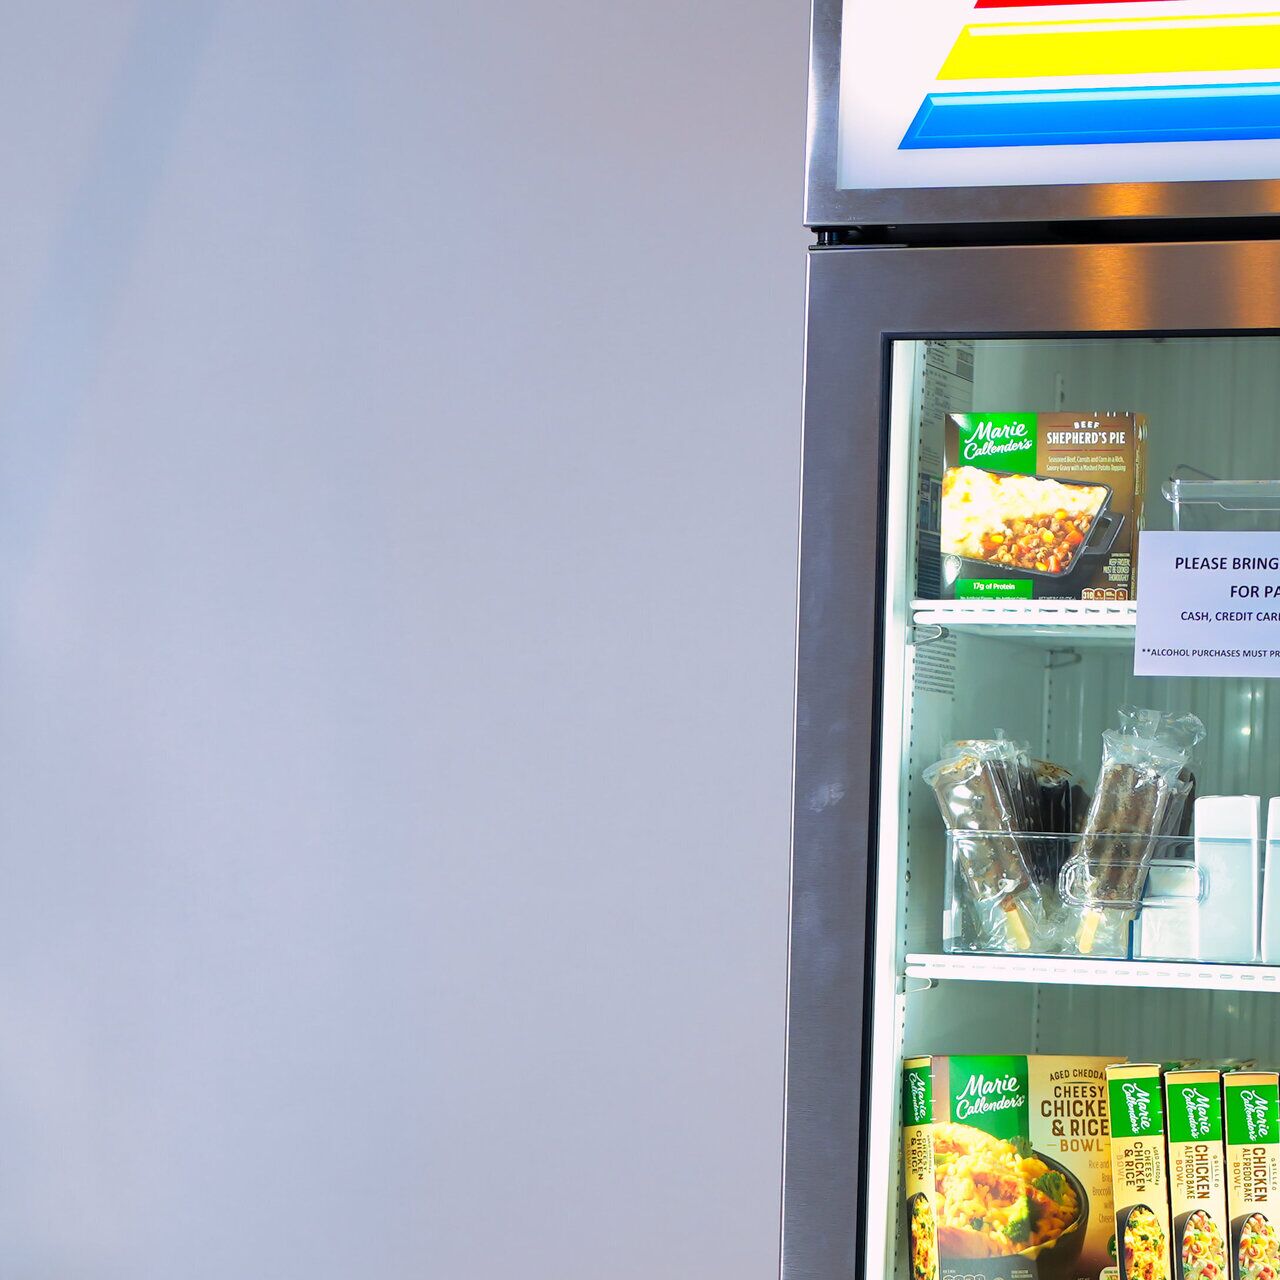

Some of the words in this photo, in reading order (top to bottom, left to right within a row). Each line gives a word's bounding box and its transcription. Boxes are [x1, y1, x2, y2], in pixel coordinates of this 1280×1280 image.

[1074, 421, 1100, 429] BEEF
[964, 421, 1028, 444] Marie
[1046, 432, 1108, 444] SHEPHERD'S
[1109, 432, 1125, 444] PIE
[964, 439, 1032, 460] Callender's
[1175, 557, 1228, 571] PLEASE
[1232, 557, 1279, 571] BRING
[973, 582, 984, 591] 17g
[993, 582, 1016, 590] Protein
[1230, 585, 1259, 599] FOR
[1181, 611, 1212, 622] CASH,
[1215, 611, 1253, 622] CREDIT
[1192, 650, 1241, 658] PURCHASES
[1242, 650, 1267, 658] MUST
[1050, 1070, 1070, 1081] AGED
[956, 1074, 1020, 1101] Marie
[1054, 1086, 1105, 1098] CHEESY
[955, 1095, 1025, 1120] Callender's
[1182, 1088, 1198, 1139] Callender's
[1192, 1087, 1210, 1136] Marie
[1052, 1120, 1065, 1136] &
[1070, 1119, 1109, 1136] RICE
[1060, 1139, 1104, 1152] BOWL
[1194, 1144, 1210, 1199] CHICKEN
